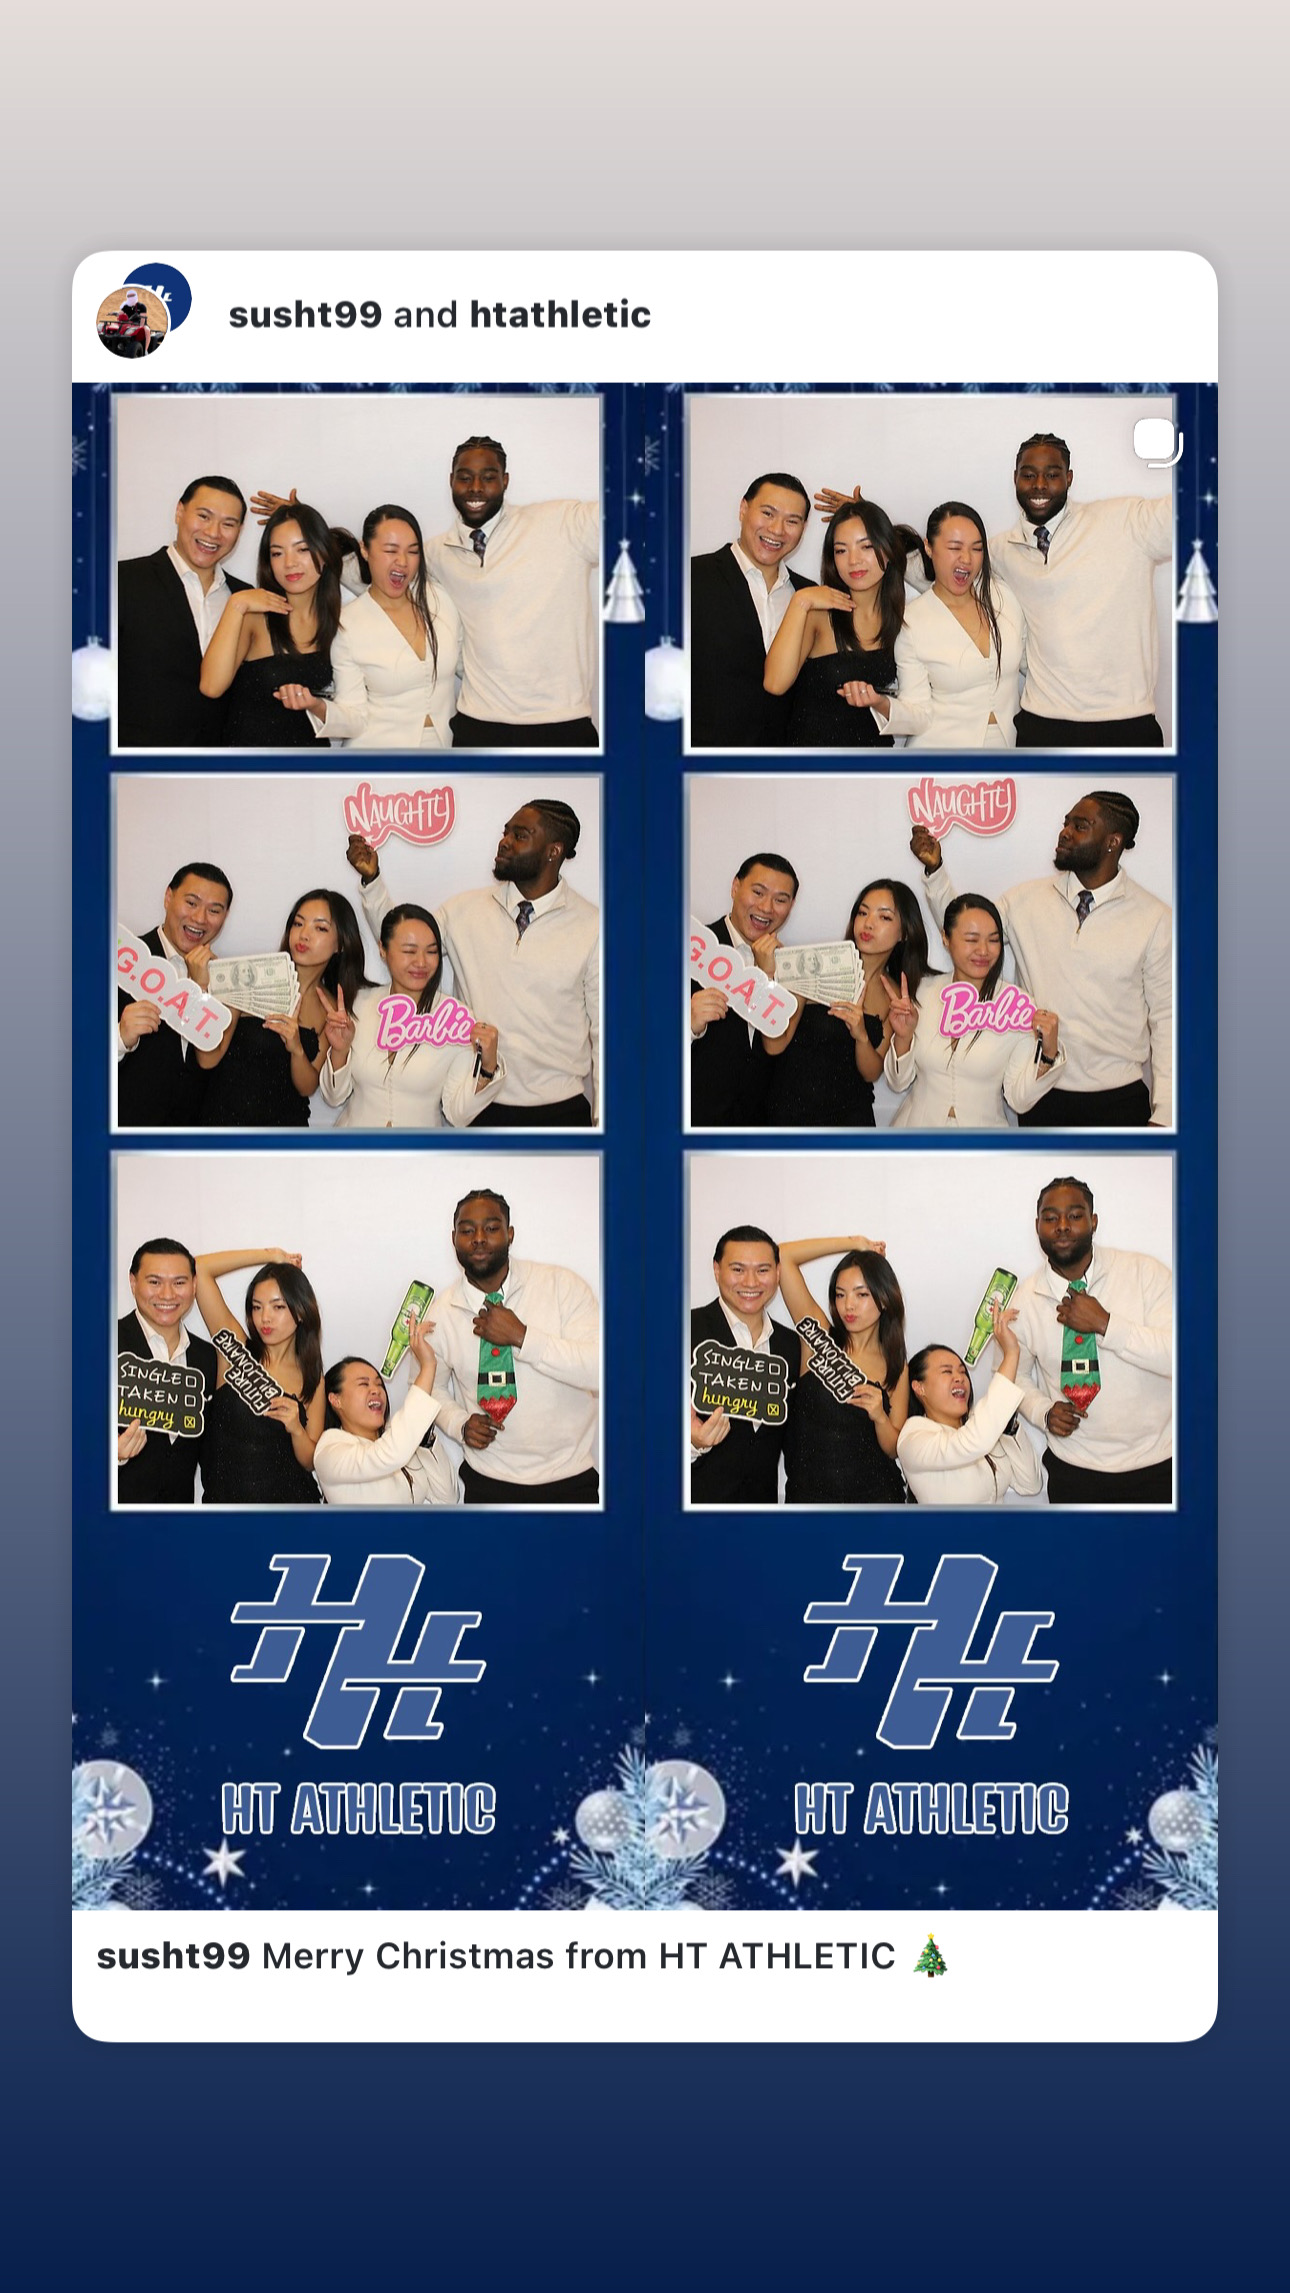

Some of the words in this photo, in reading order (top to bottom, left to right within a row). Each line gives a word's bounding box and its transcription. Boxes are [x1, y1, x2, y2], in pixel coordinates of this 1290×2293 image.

[349, 787, 450, 840] NAUGHTY
[912, 779, 1011, 830] NAUGHTY
[381, 1000, 471, 1047] Barbie
[944, 987, 1032, 1033] Barbie
[120, 1361, 182, 1385] SINGLE
[216, 1330, 279, 1398] BILLIONAIRE
[703, 1349, 765, 1372] SINGLE
[800, 1319, 862, 1388] BILLIONAIRE
[118, 1384, 179, 1404] TAKEN
[228, 1369, 267, 1410] FUTURE
[699, 1372, 762, 1391] TAKEN
[811, 1357, 850, 1398] FUTURE
[119, 1399, 174, 1429] hungry
[702, 1386, 757, 1416] hungry
